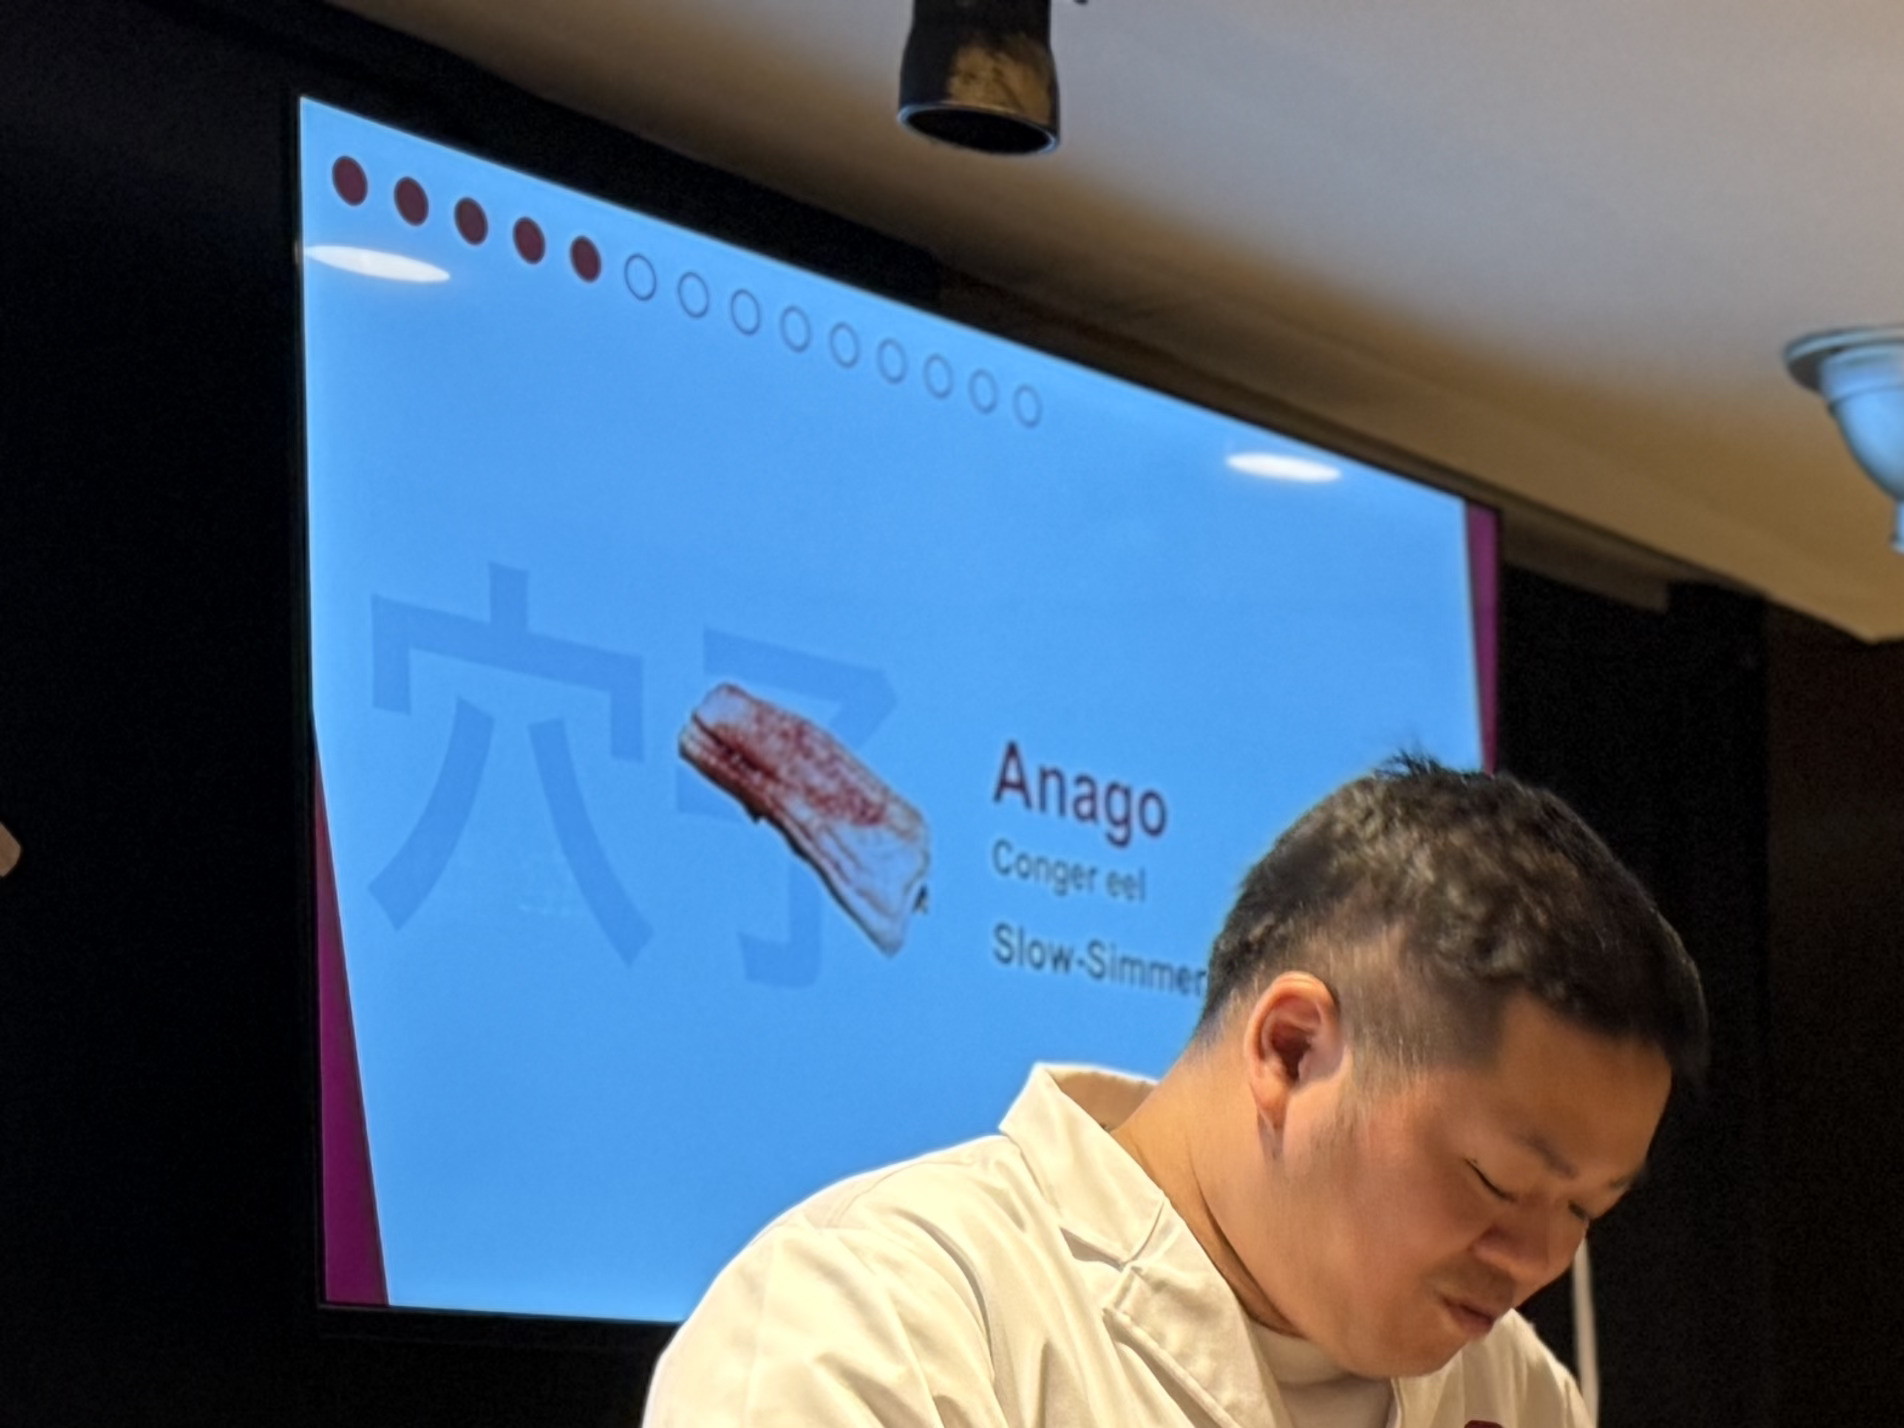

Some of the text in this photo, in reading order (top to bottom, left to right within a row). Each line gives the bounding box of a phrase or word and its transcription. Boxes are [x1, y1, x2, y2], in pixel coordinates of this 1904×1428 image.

[993, 740, 1168, 848] Anago
[992, 838, 1147, 901] Conger eel
[993, 922, 1207, 997] Slow-Simmer
